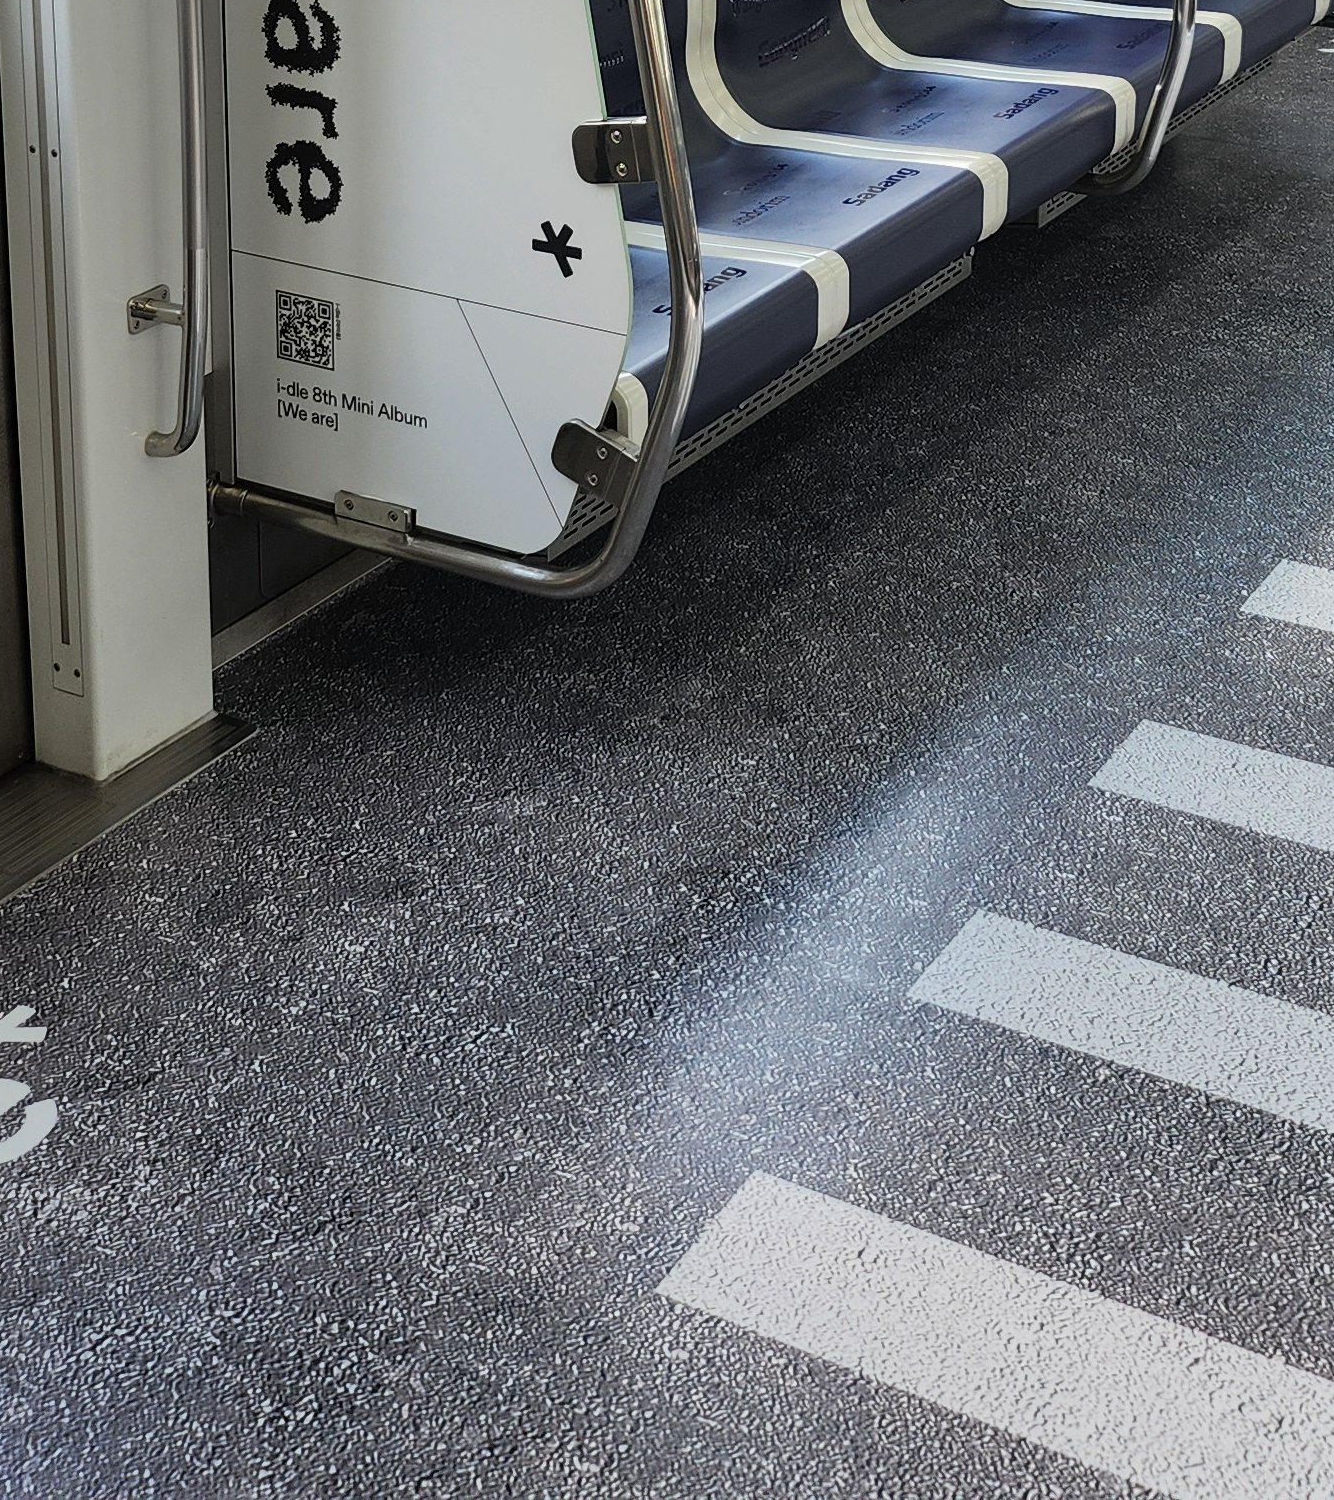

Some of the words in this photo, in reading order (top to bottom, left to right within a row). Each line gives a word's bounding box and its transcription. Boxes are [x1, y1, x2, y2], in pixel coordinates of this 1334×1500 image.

[992, 86, 1059, 121] Sadang
[842, 166, 921, 207] Sadang
[652, 266, 748, 316] Sang
[277, 378, 309, 400] i-dle
[312, 386, 338, 407] 8th
[341, 393, 374, 416] Mini
[377, 402, 428, 429] Album
[277, 398, 308, 422] [We
[311, 411, 339, 432] are]
